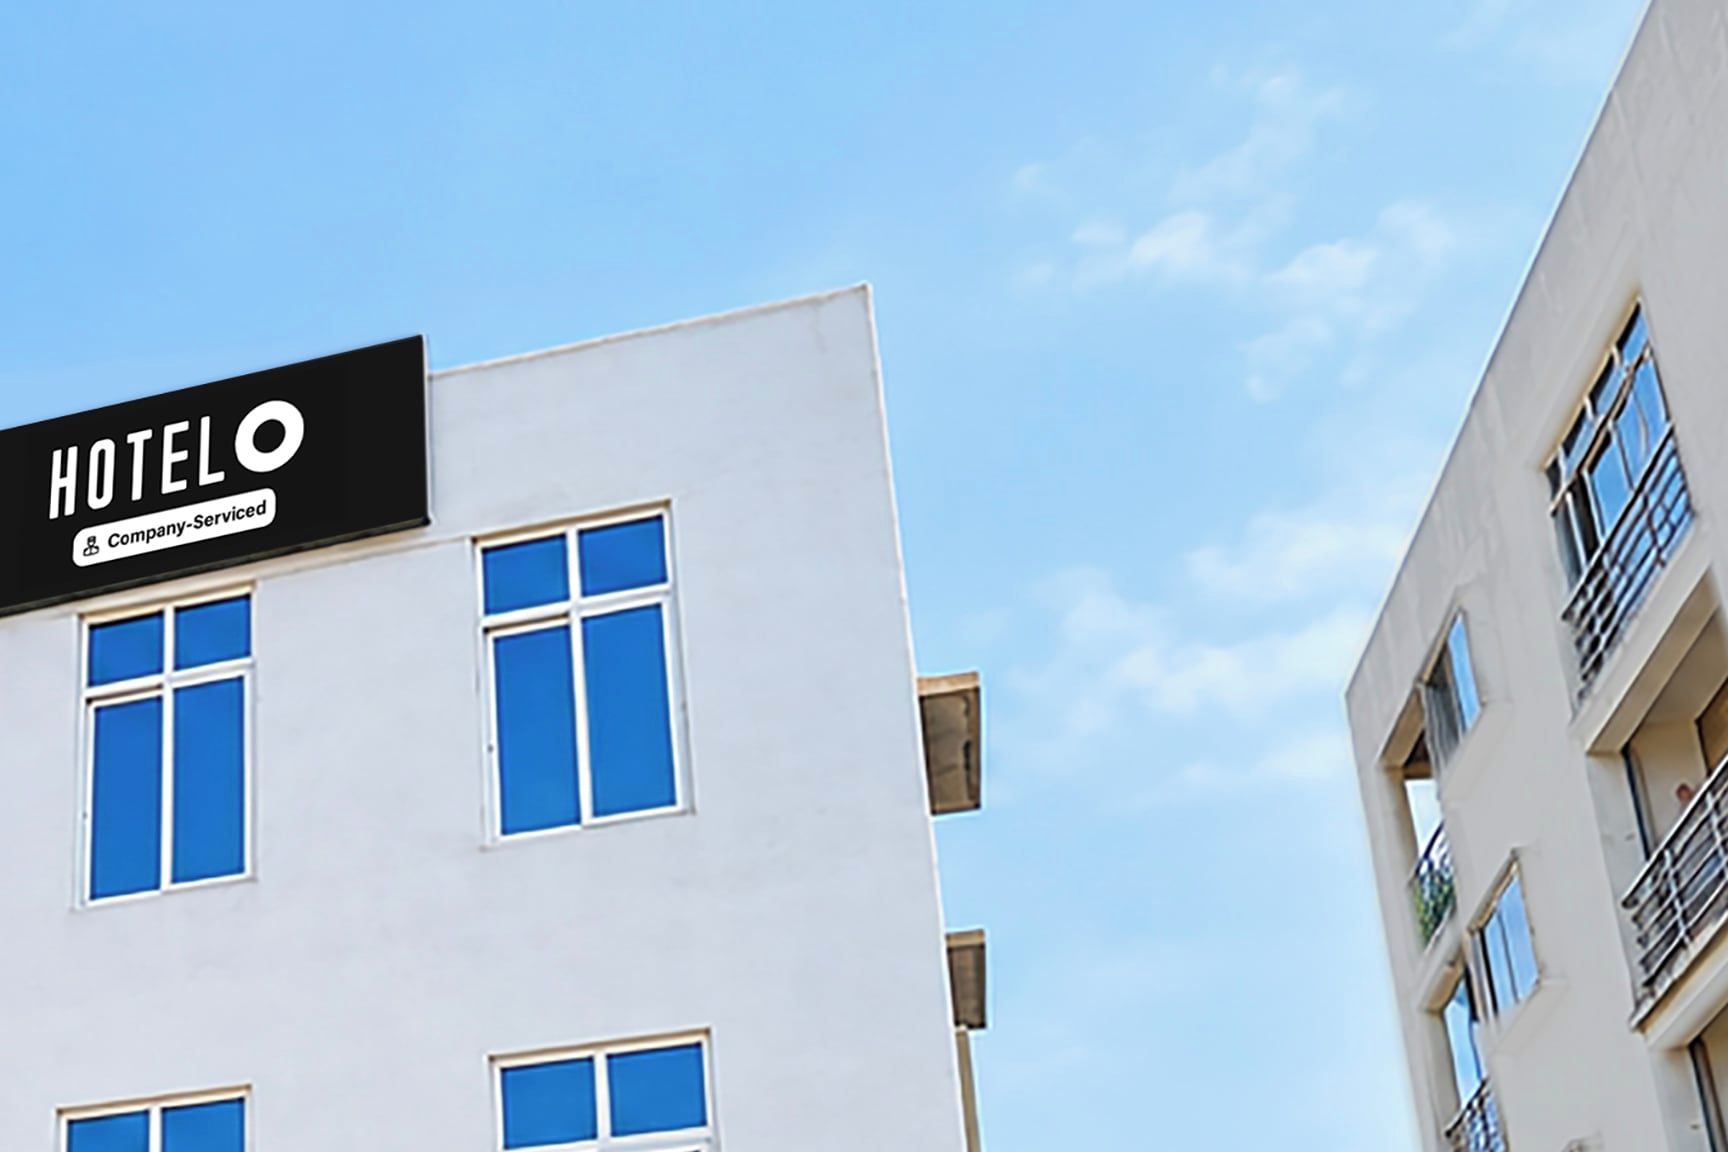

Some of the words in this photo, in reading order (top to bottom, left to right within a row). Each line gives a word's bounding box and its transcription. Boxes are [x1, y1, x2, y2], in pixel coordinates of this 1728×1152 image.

[49, 415, 225, 520] HOTEL
[234, 400, 305, 473] O
[107, 499, 267, 548] Company-Serviced
